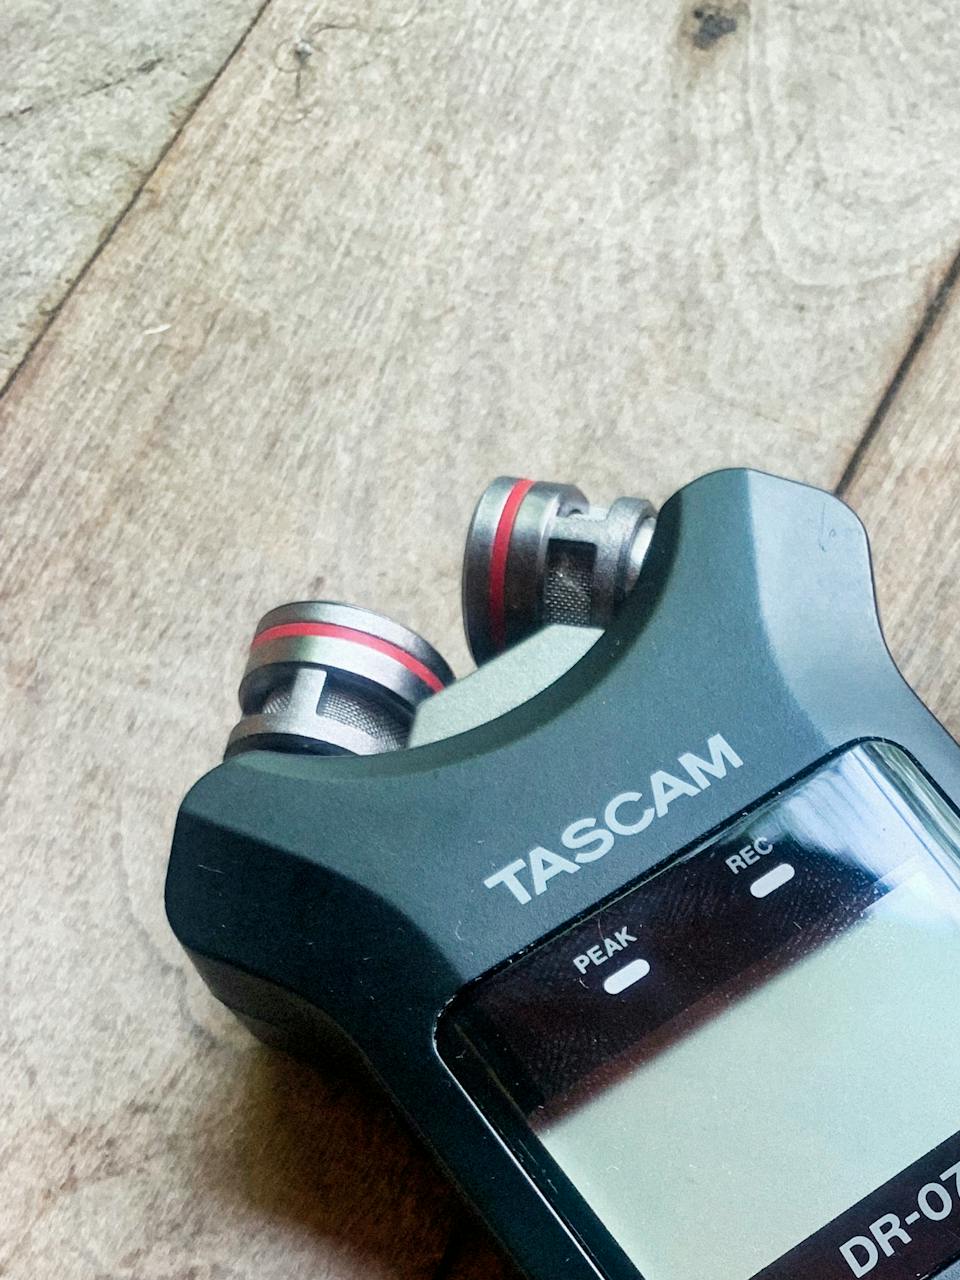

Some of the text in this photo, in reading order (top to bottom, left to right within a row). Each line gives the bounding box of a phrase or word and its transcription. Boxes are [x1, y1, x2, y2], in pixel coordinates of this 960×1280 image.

[484, 733, 743, 905] TASCAM
[726, 836, 775, 875] REC
[573, 926, 638, 975] PEAK
